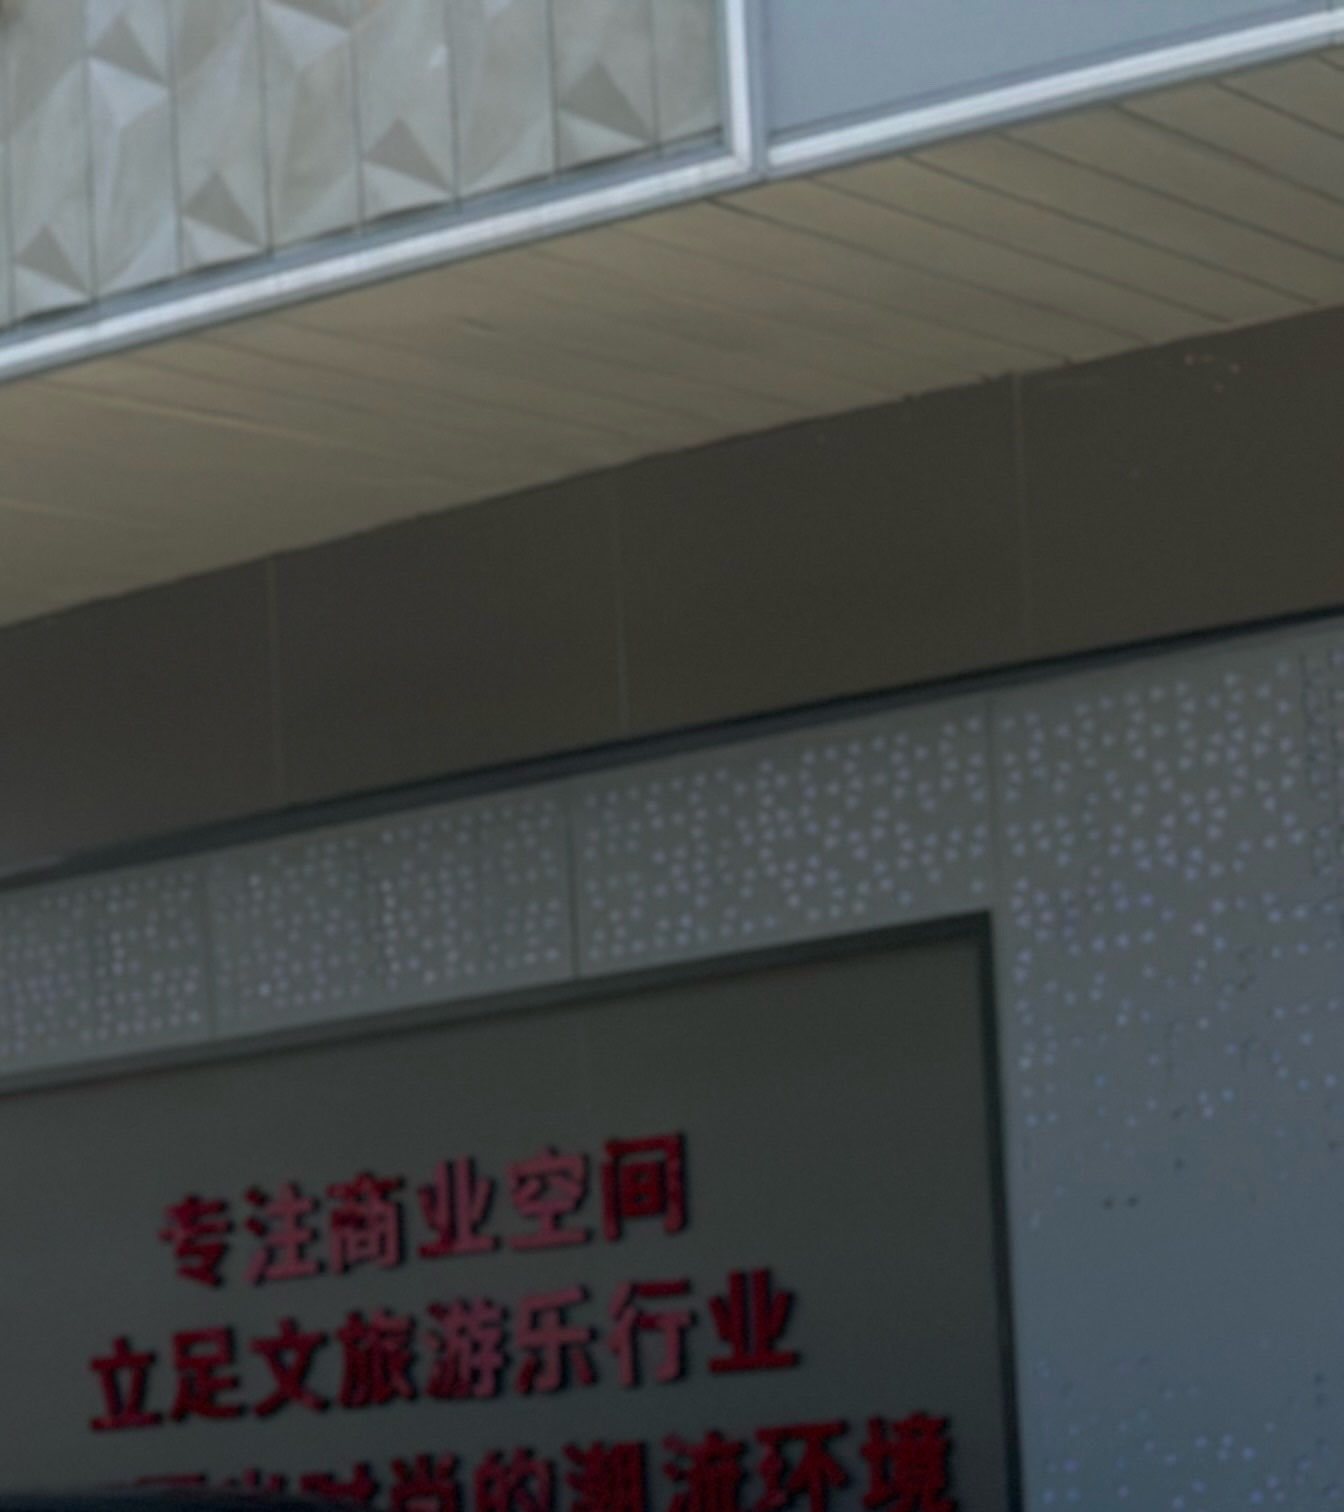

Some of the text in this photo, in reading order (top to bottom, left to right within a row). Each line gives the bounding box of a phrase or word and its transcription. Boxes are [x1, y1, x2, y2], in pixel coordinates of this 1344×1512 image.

[159, 1132, 686, 1288] 专注商业空间
[89, 1268, 798, 1433] 立足文旅游乐行业
